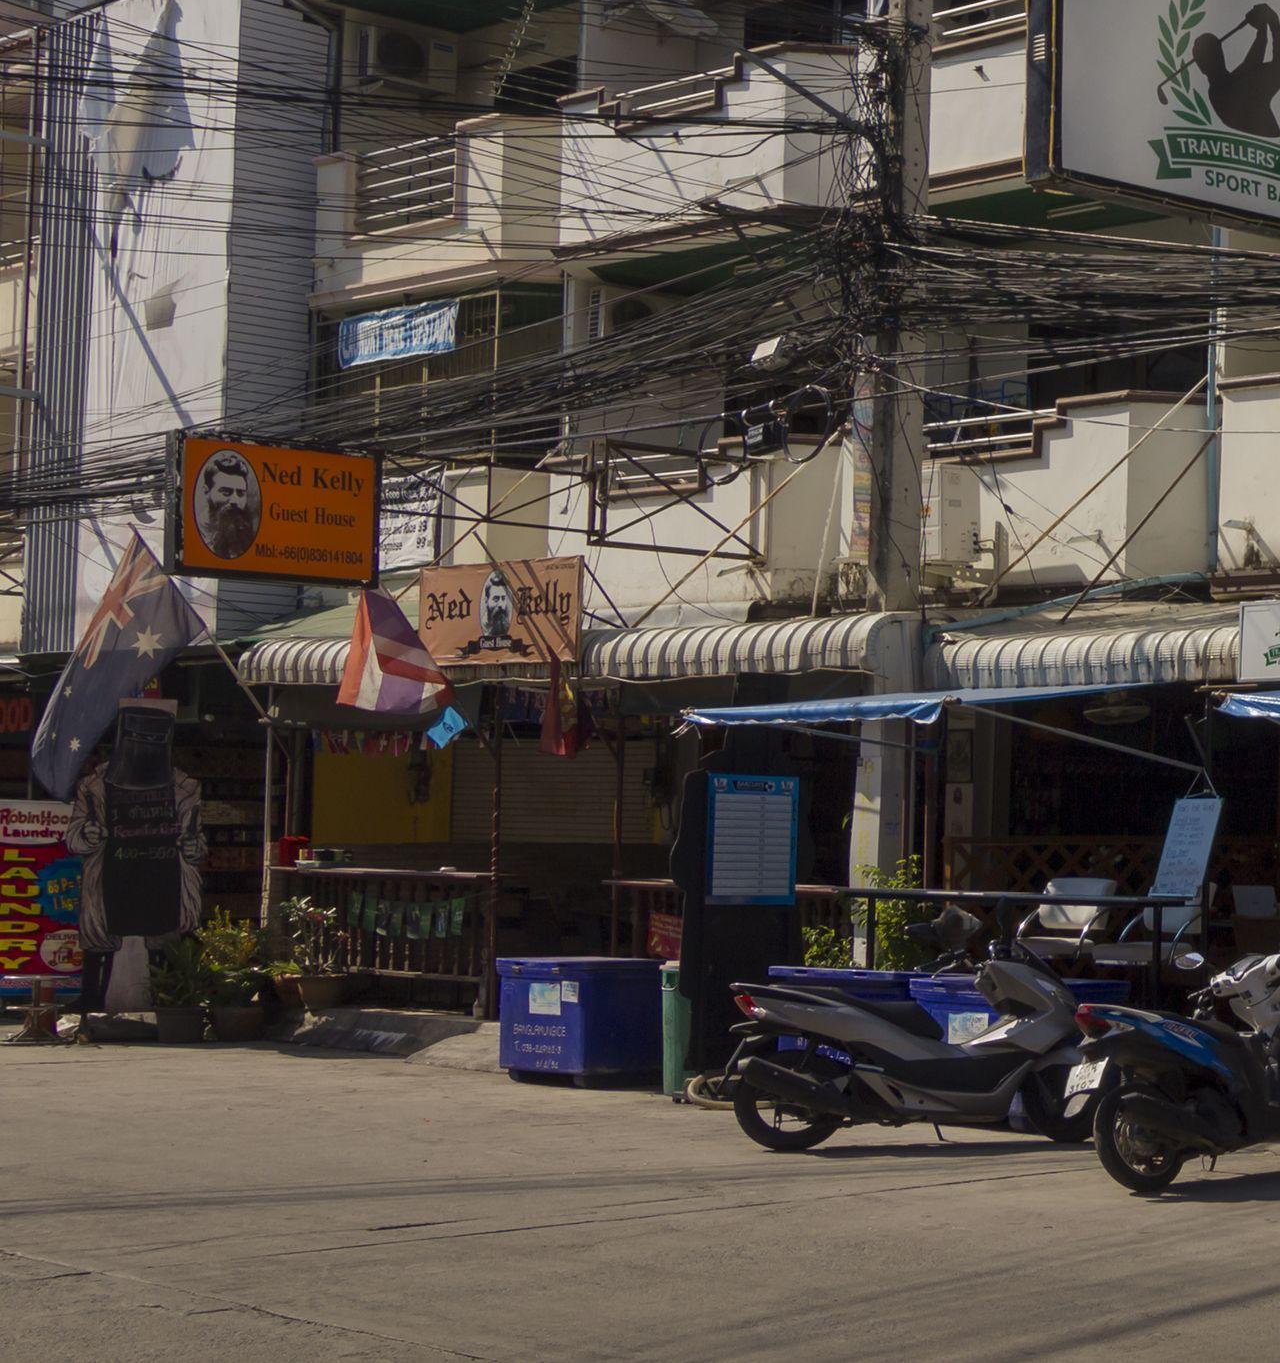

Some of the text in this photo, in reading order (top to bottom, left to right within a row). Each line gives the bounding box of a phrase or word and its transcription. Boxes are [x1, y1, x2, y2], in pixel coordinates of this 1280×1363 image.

[1205, 169, 1261, 197] SPORT
[262, 462, 365, 497] Ned Kelly
[269, 502, 308, 524] Guest
[314, 507, 356, 527] House
[425, 579, 571, 630] Ned Kelly
[480, 639, 495, 648] Guest
[3, 829, 64, 842] Laundry
[0, 849, 41, 970] LAUNDRY
